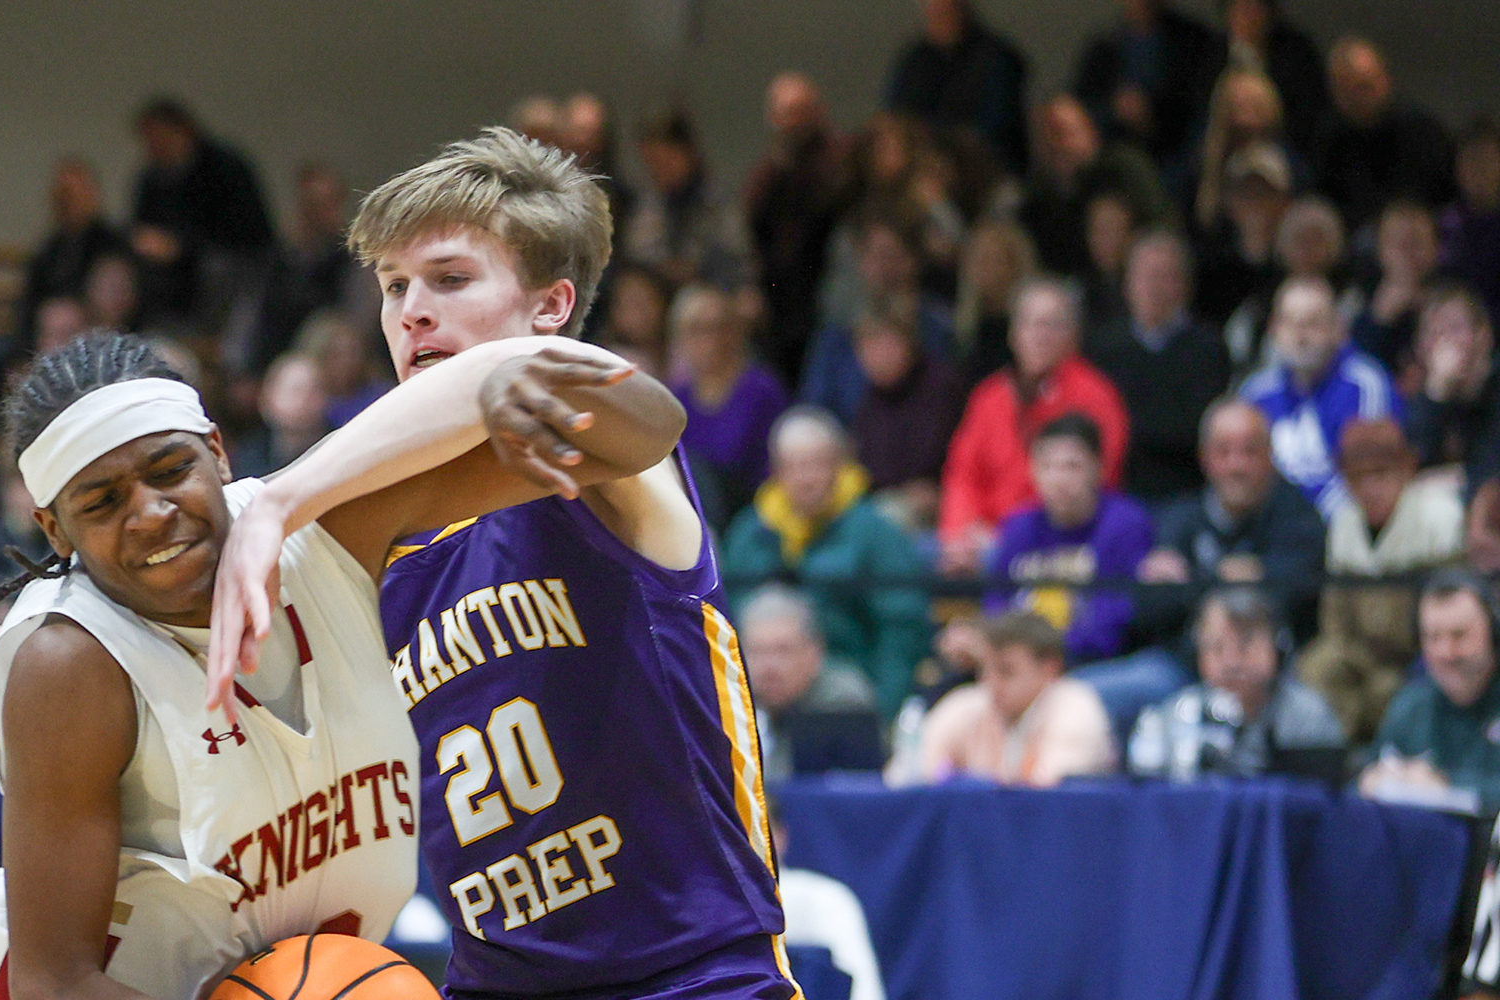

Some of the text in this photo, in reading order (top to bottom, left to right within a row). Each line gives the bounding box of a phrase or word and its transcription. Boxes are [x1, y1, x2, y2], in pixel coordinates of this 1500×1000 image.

[389, 578, 587, 712] RANTON
[213, 759, 415, 913] KNIGHTS
[435, 696, 565, 847] 20
[449, 815, 624, 941] PREP
